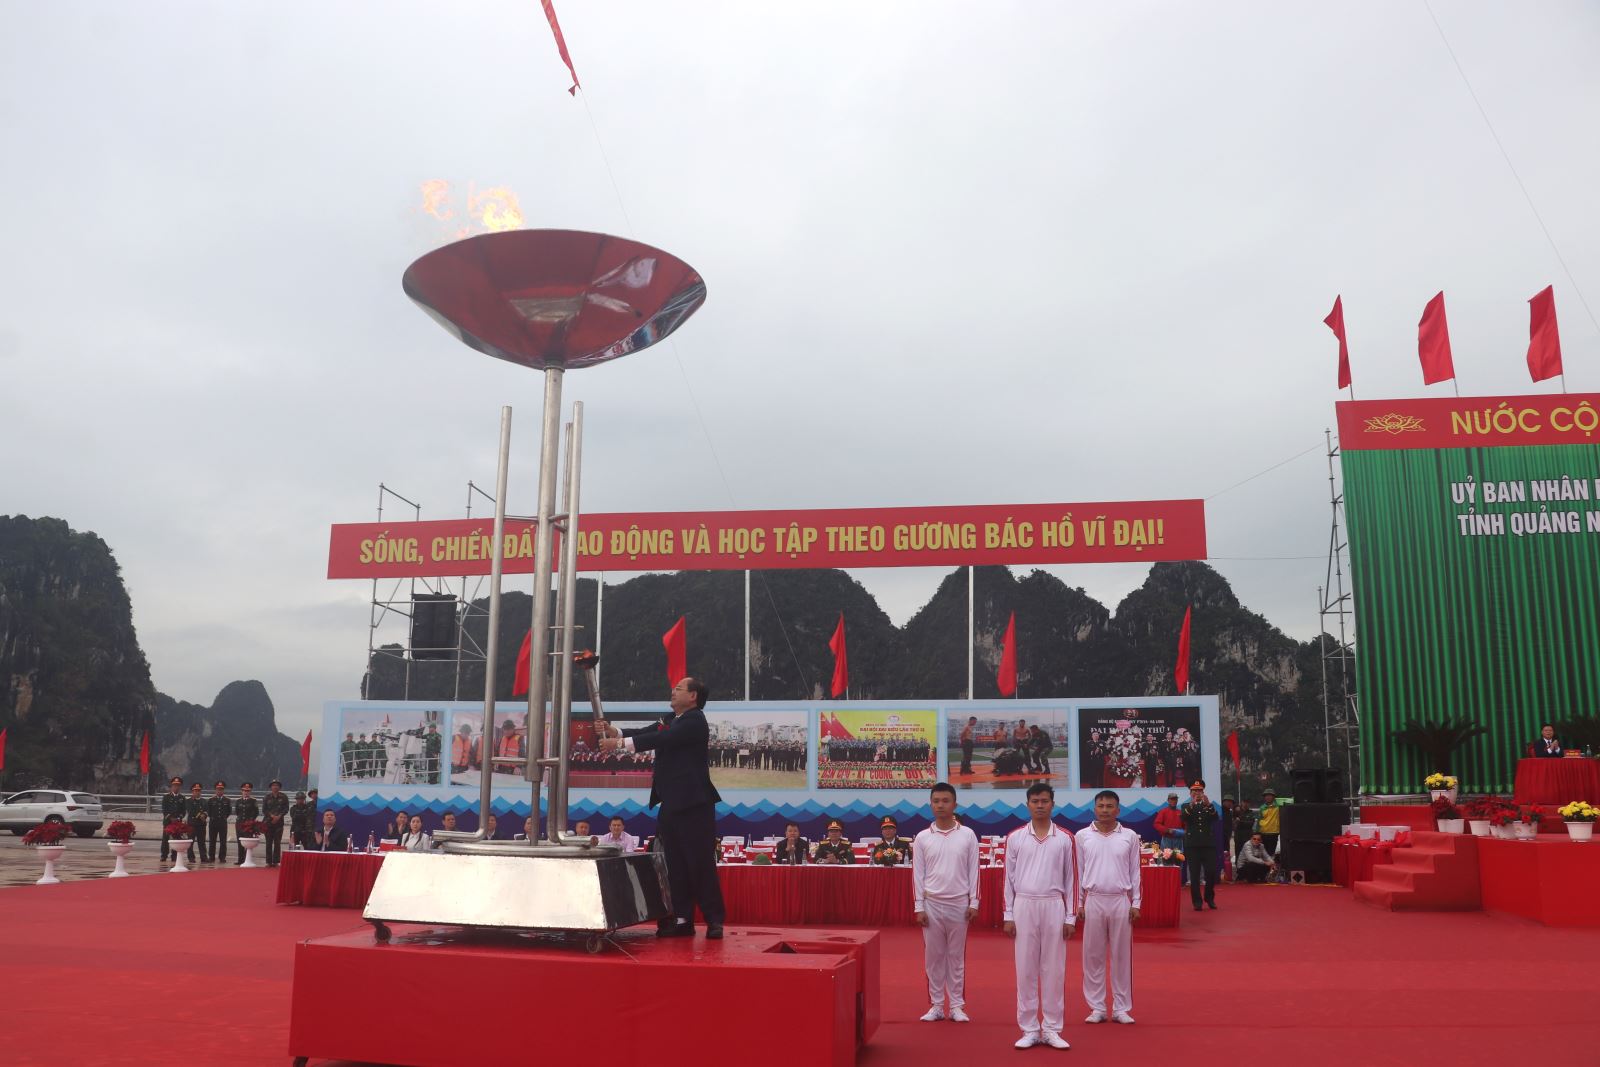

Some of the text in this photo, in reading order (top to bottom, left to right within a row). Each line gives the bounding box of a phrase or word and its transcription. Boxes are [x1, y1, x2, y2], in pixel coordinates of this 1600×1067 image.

[1451, 400, 1599, 437] NƯỚC CỘ
[1483, 480, 1525, 503] BAN
[1530, 475, 1589, 502] NHÂN
[1457, 507, 1505, 536] TỈNH
[1511, 504, 1581, 537] QUẢNG
[360, 530, 424, 565] SỐNG,
[431, 528, 494, 562] CHIẾN
[572, 530, 604, 556] AO
[610, 524, 674, 561] ĐỘNG
[681, 523, 711, 554] VÀ
[719, 527, 766, 559] HỌC
[773, 522, 818, 559] TẬP
[826, 526, 885, 552] THEO
[894, 522, 976, 551] GƯƠNG
[985, 517, 1034, 549] BÁC
[1042, 512, 1075, 547] HỒ
[1082, 516, 1106, 547] VĨ
[1113, 519, 1164, 552] ĐẠI!
